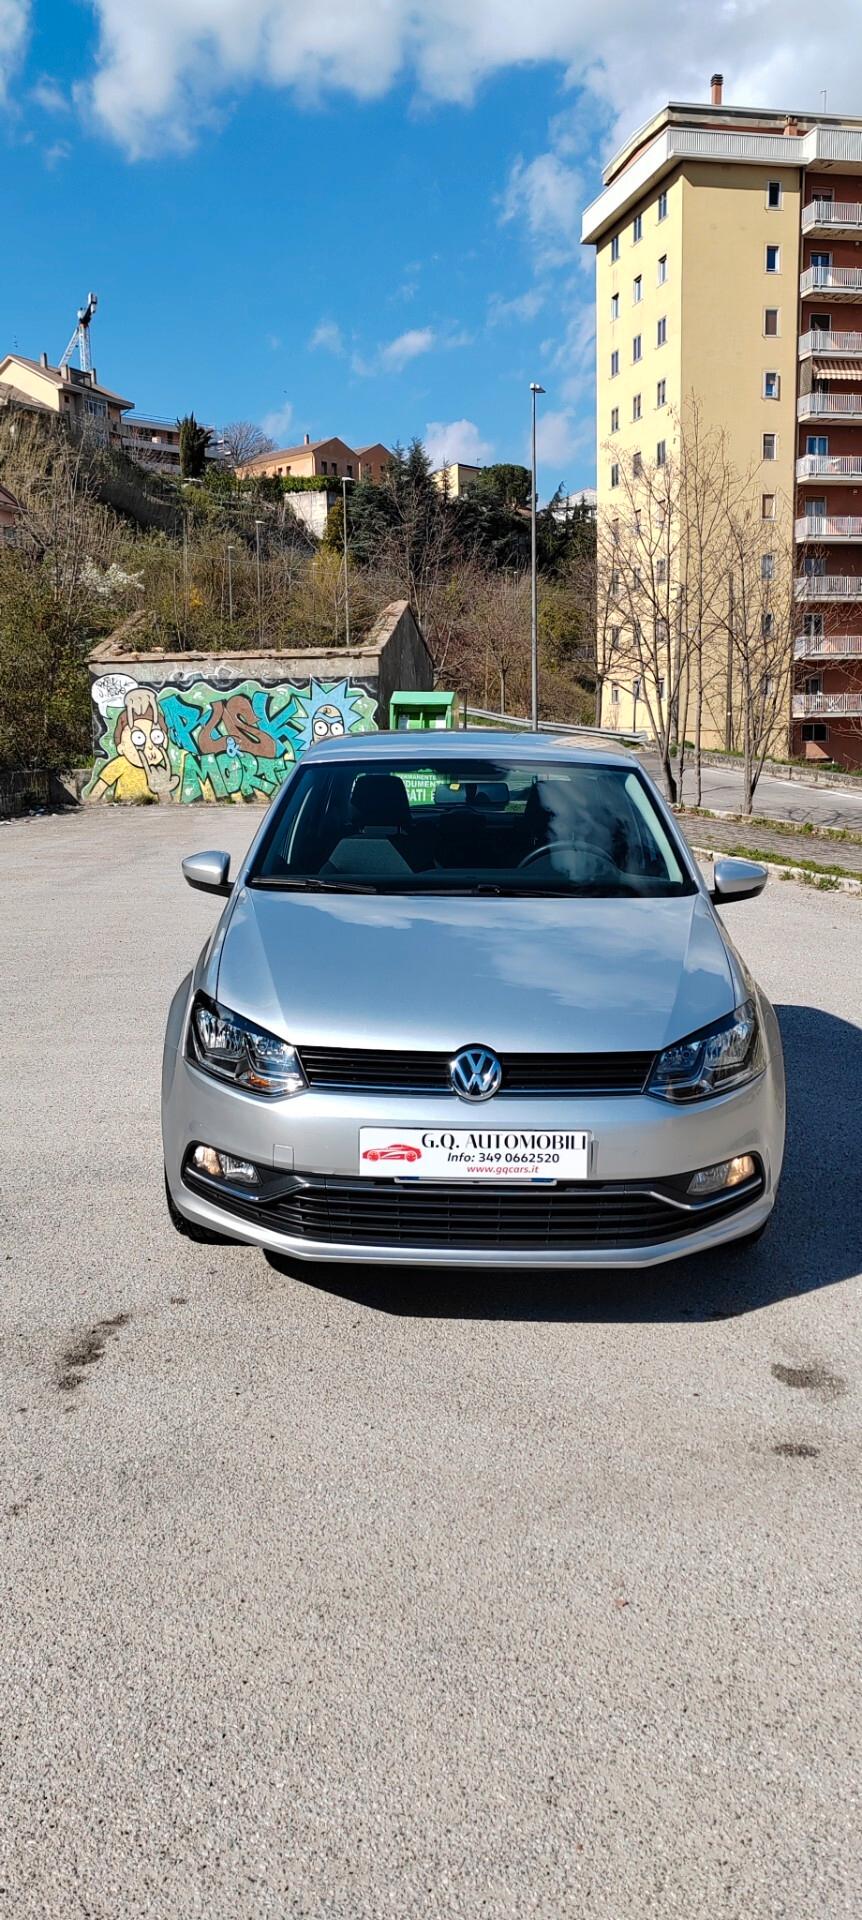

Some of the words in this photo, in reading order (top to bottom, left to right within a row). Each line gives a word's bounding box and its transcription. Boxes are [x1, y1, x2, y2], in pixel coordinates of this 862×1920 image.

[421, 1132, 460, 1150] G.Q.
[465, 1133, 586, 1150] AUTOMOBILI
[447, 1152, 475, 1163] Info:
[478, 1152, 502, 1163] 349
[504, 1153, 560, 1164] 0662520
[466, 1165, 539, 1175] www.gqcars.it
